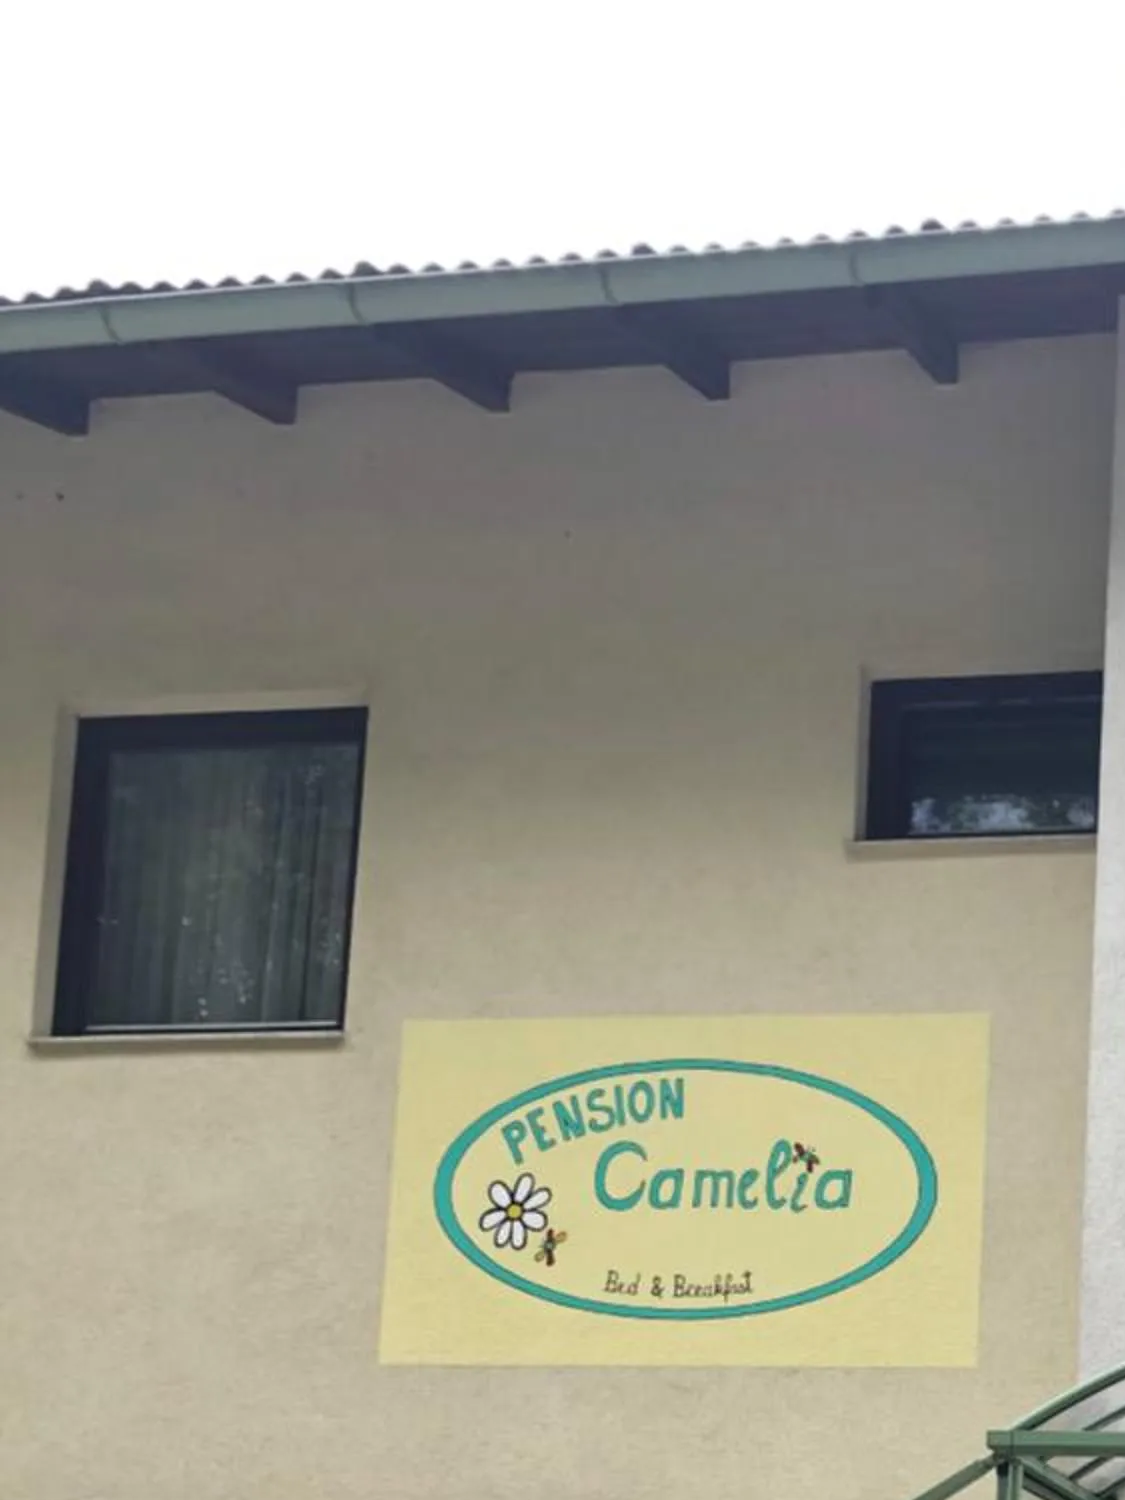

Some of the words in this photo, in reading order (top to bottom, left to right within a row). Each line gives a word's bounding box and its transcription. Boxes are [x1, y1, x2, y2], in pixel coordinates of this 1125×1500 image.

[501, 1077, 685, 1165] PENSION
[594, 1139, 854, 1213] Camelia
[604, 1269, 642, 1296] Bed
[651, 1275, 665, 1299] &
[673, 1270, 753, 1303] Breakfast
